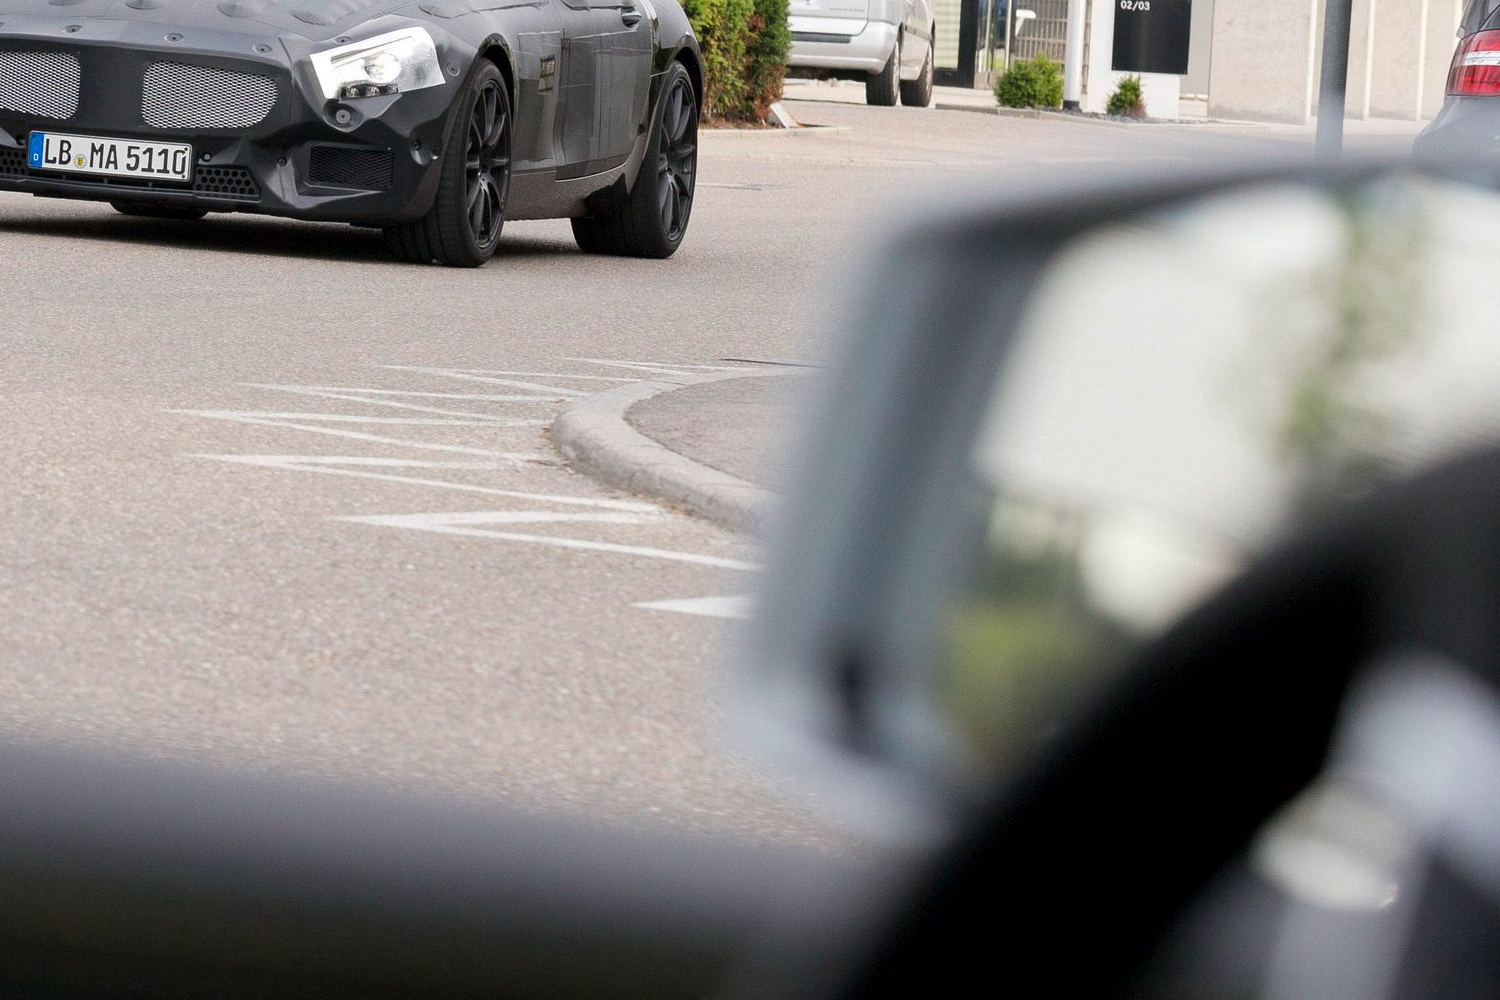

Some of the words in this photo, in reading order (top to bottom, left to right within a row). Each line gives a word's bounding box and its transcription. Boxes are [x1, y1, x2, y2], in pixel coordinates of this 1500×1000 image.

[1120, 0, 1150, 11] 02/03
[44, 138, 72, 165] LB
[89, 142, 119, 170] MA
[126, 146, 187, 175] 5110
